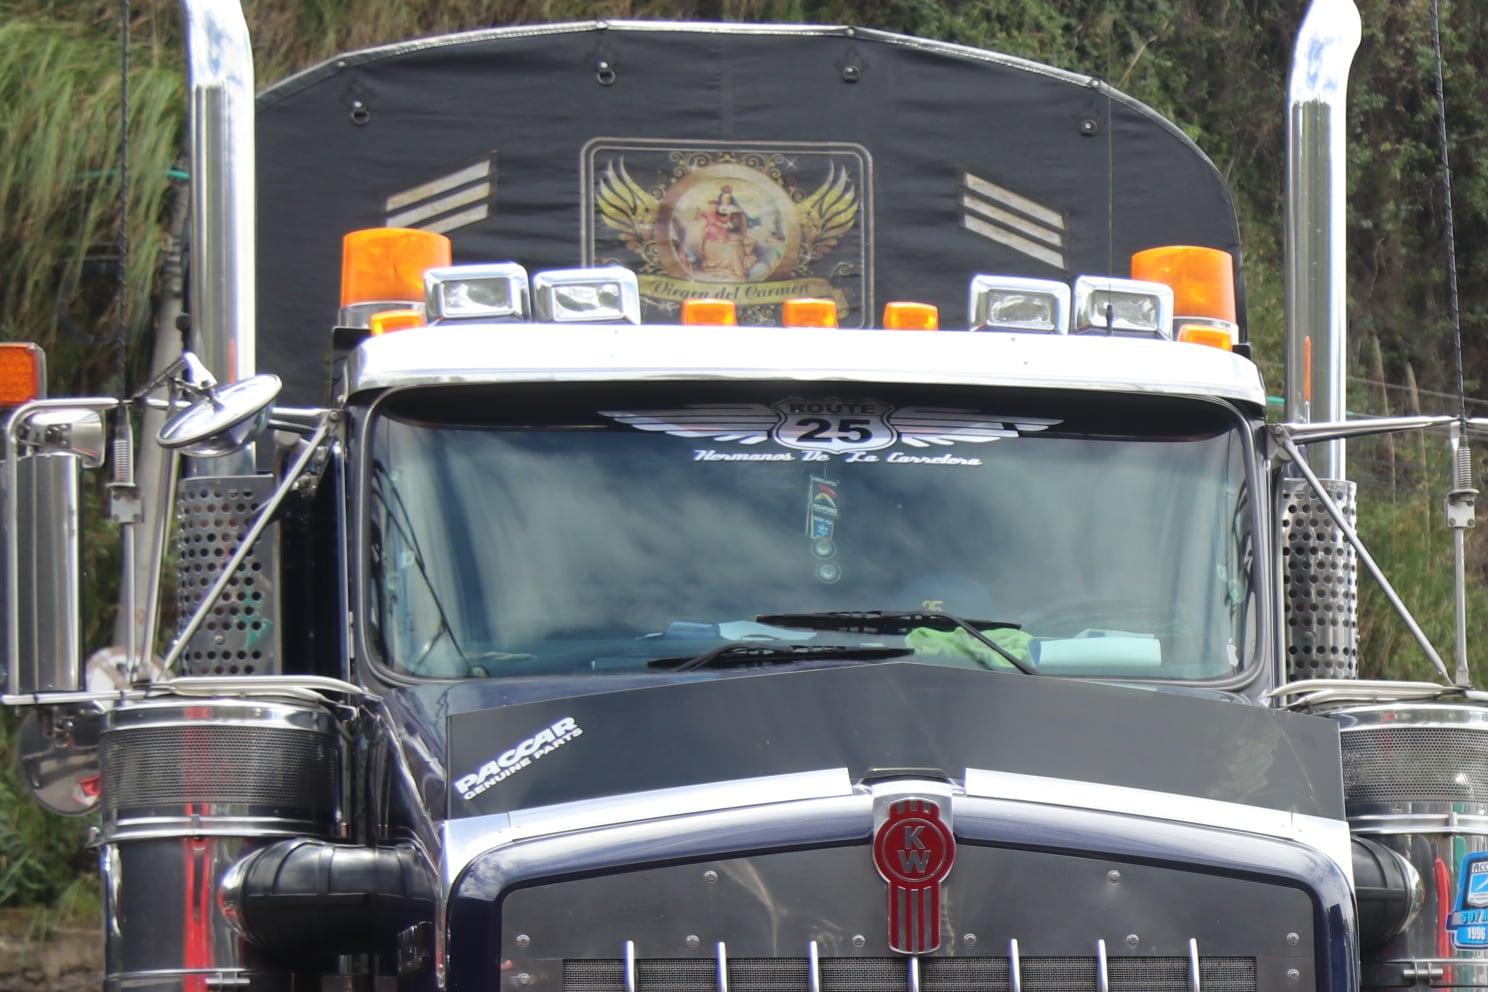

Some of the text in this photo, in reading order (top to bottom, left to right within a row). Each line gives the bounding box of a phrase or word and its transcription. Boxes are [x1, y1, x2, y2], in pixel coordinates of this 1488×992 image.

[654, 280, 809, 300] Virgen del Carmen
[789, 401, 876, 415] ROUTE
[796, 418, 873, 443] 25
[694, 449, 983, 466] Hermanos De La Carretera
[454, 716, 578, 794] PACCAR
[463, 728, 583, 800] GENUINE PARTS
[1461, 912, 1480, 923] SOY
[1468, 927, 1486, 941] 1996
